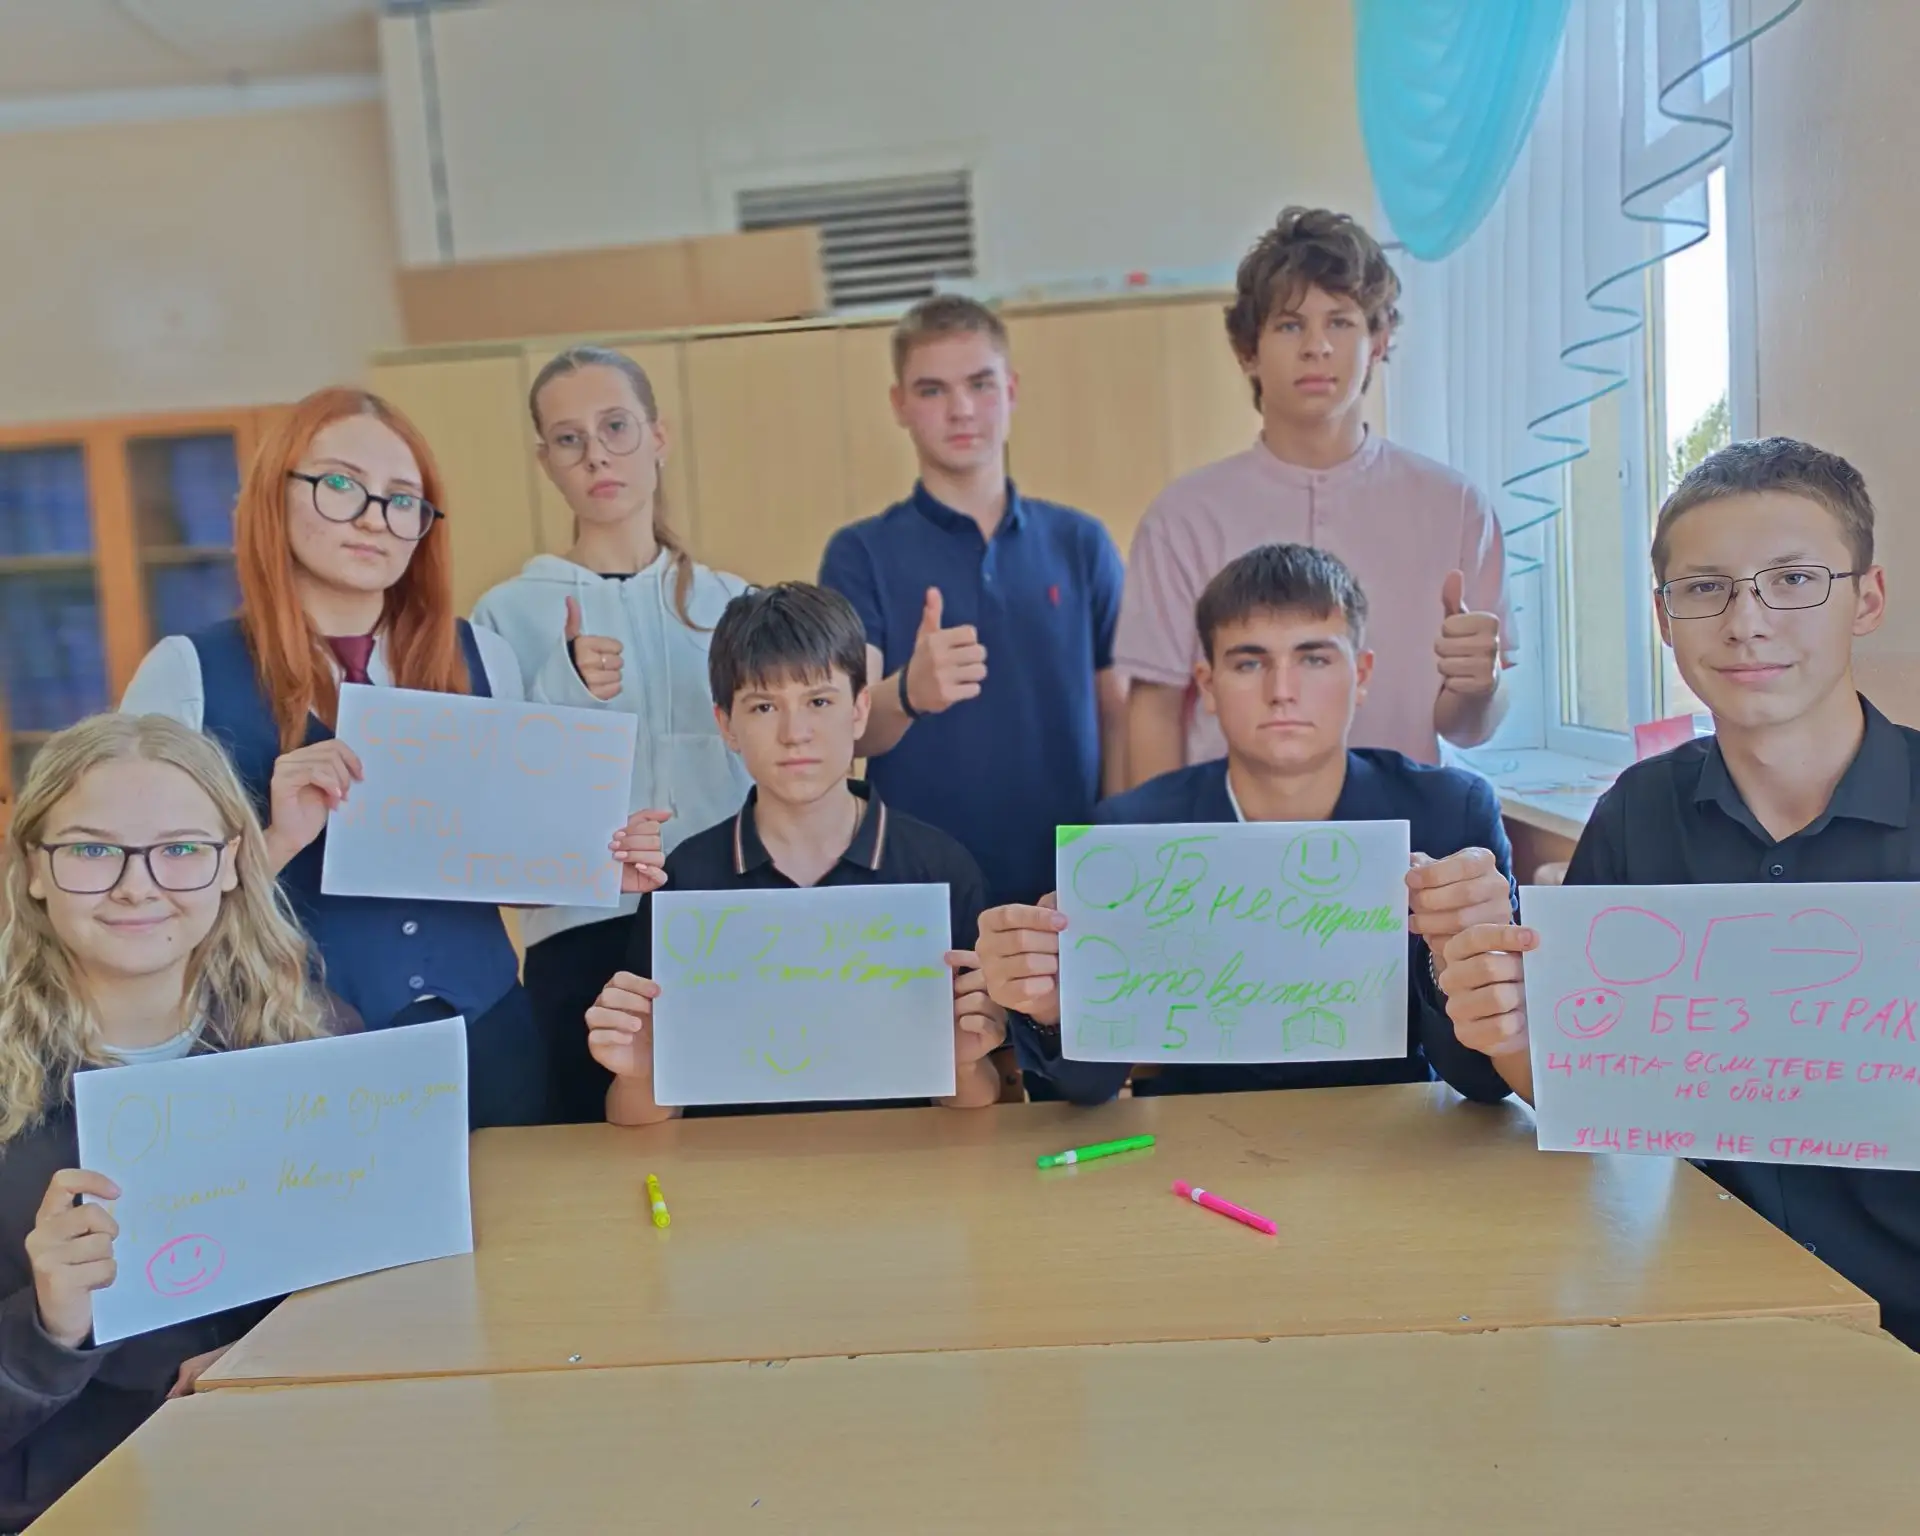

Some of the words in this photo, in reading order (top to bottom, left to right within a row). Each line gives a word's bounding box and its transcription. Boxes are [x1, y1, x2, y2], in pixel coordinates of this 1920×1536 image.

[1208, 884, 1274, 926] не
[1585, 905, 1864, 997] ОГЭ
[1162, 1004, 1198, 1050] 5
[1649, 993, 1751, 1034] БЕЗ
[1764, 1057, 1846, 1084] ТЕБЕ
[1856, 1061, 1920, 1084] СТРА
[1571, 1126, 1696, 1152] ЯЩЕНКО
[1716, 1132, 1755, 1155] НЕ
[1769, 1137, 1890, 1162] СТРАШЕН
